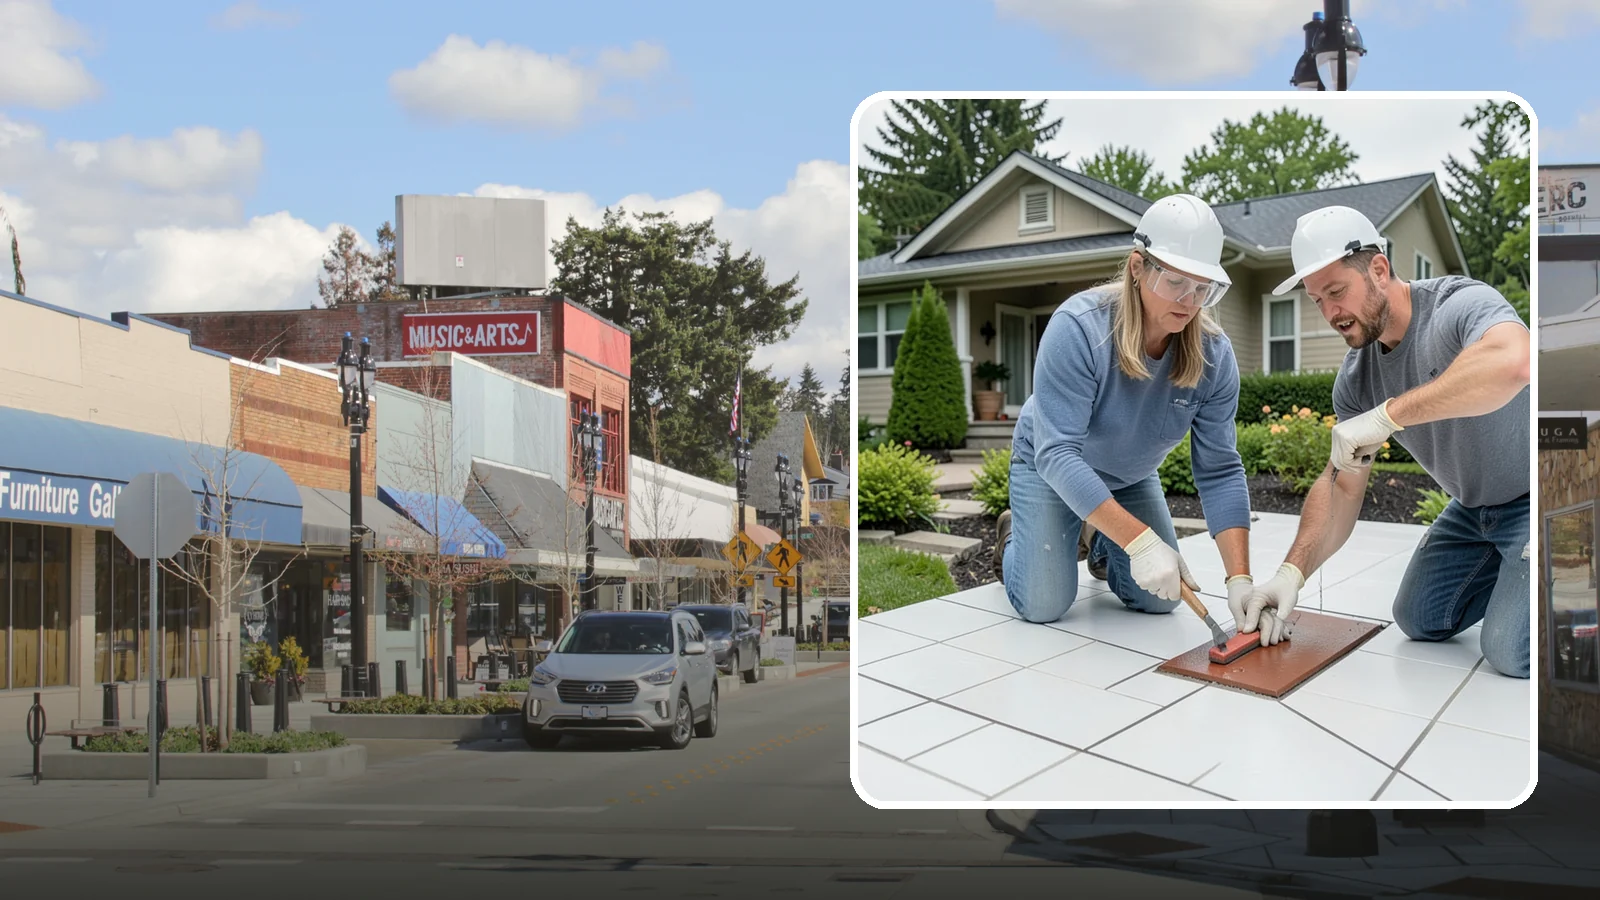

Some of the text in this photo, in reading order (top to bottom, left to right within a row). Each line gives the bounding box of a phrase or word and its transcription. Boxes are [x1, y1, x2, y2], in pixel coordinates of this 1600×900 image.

[409, 323, 520, 348] MUSIC&ARTS
[1540, 428, 1577, 437] UGA
[0, 472, 79, 515] Furniture
[453, 563, 479, 574] SUSHI
